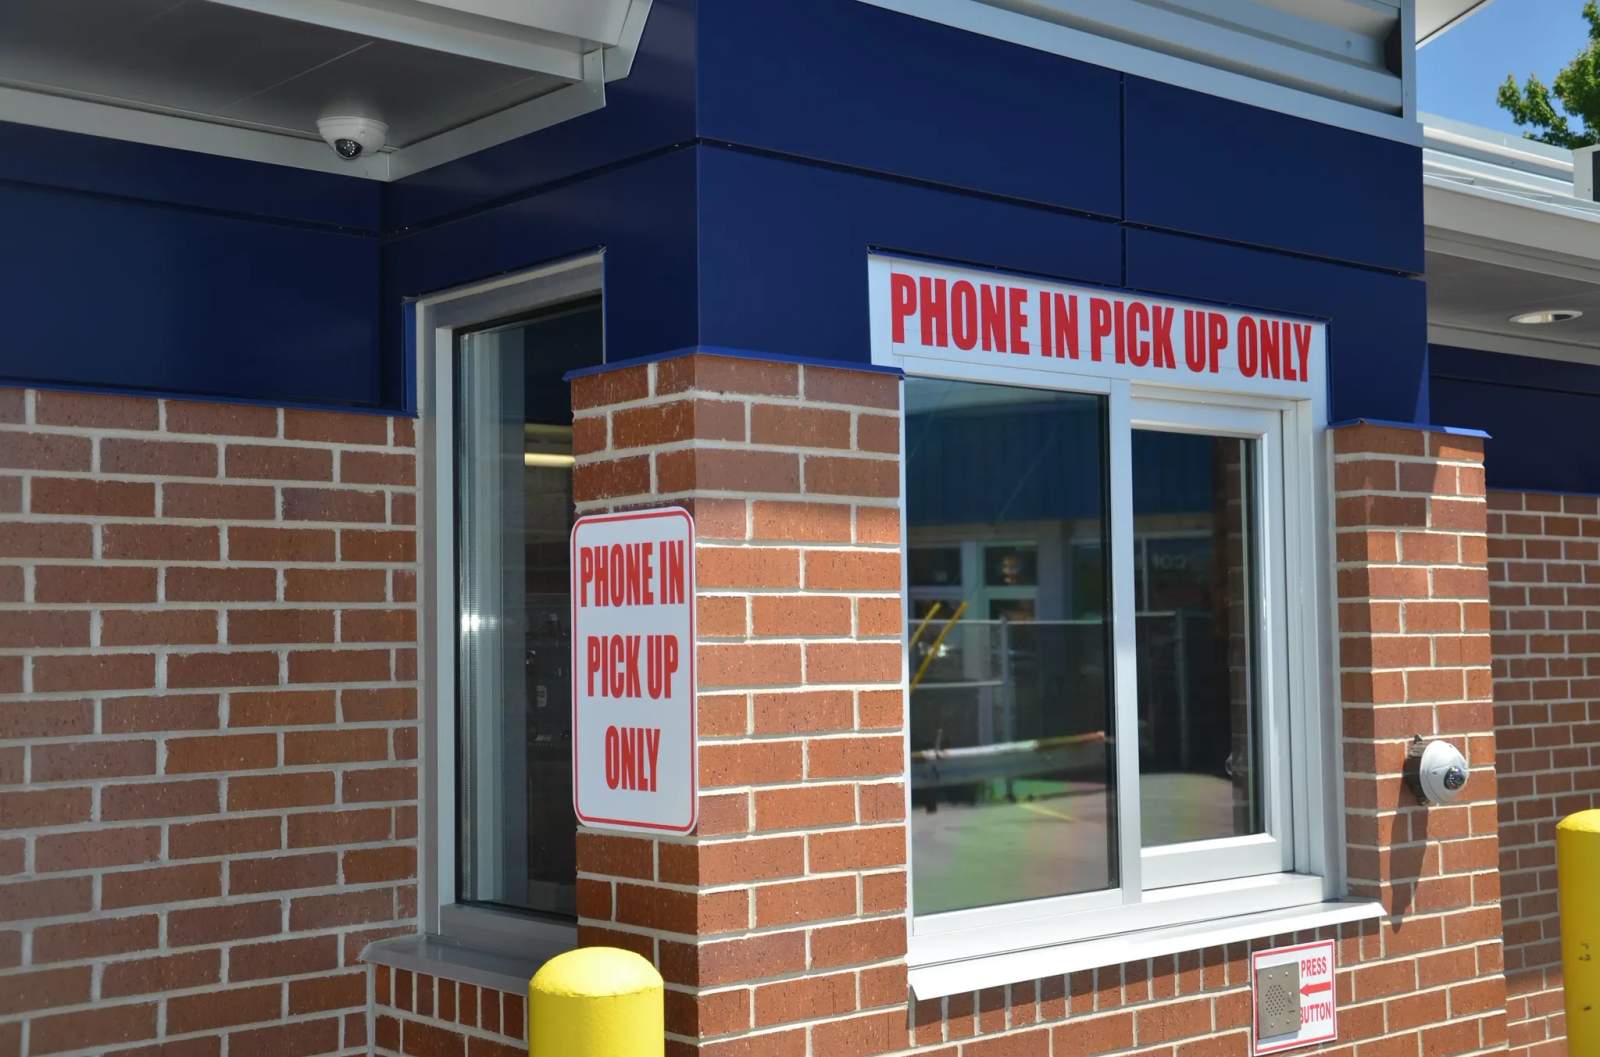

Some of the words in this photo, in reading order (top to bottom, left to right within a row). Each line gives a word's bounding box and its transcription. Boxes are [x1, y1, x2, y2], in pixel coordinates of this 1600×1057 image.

[890, 272, 1030, 355] PHONE
[1039, 291, 1080, 360] IN
[1089, 297, 1176, 369] PICK
[1184, 309, 1229, 373] UP
[1237, 315, 1312, 382] ONLY
[580, 542, 655, 608] PHONE
[660, 540, 685, 605] IN
[587, 634, 642, 699] PICK
[647, 634, 679, 700] UP
[605, 725, 661, 793] ONLY
[1301, 956, 1327, 978] PRESS
[1300, 1002, 1331, 1024] BUTTON
